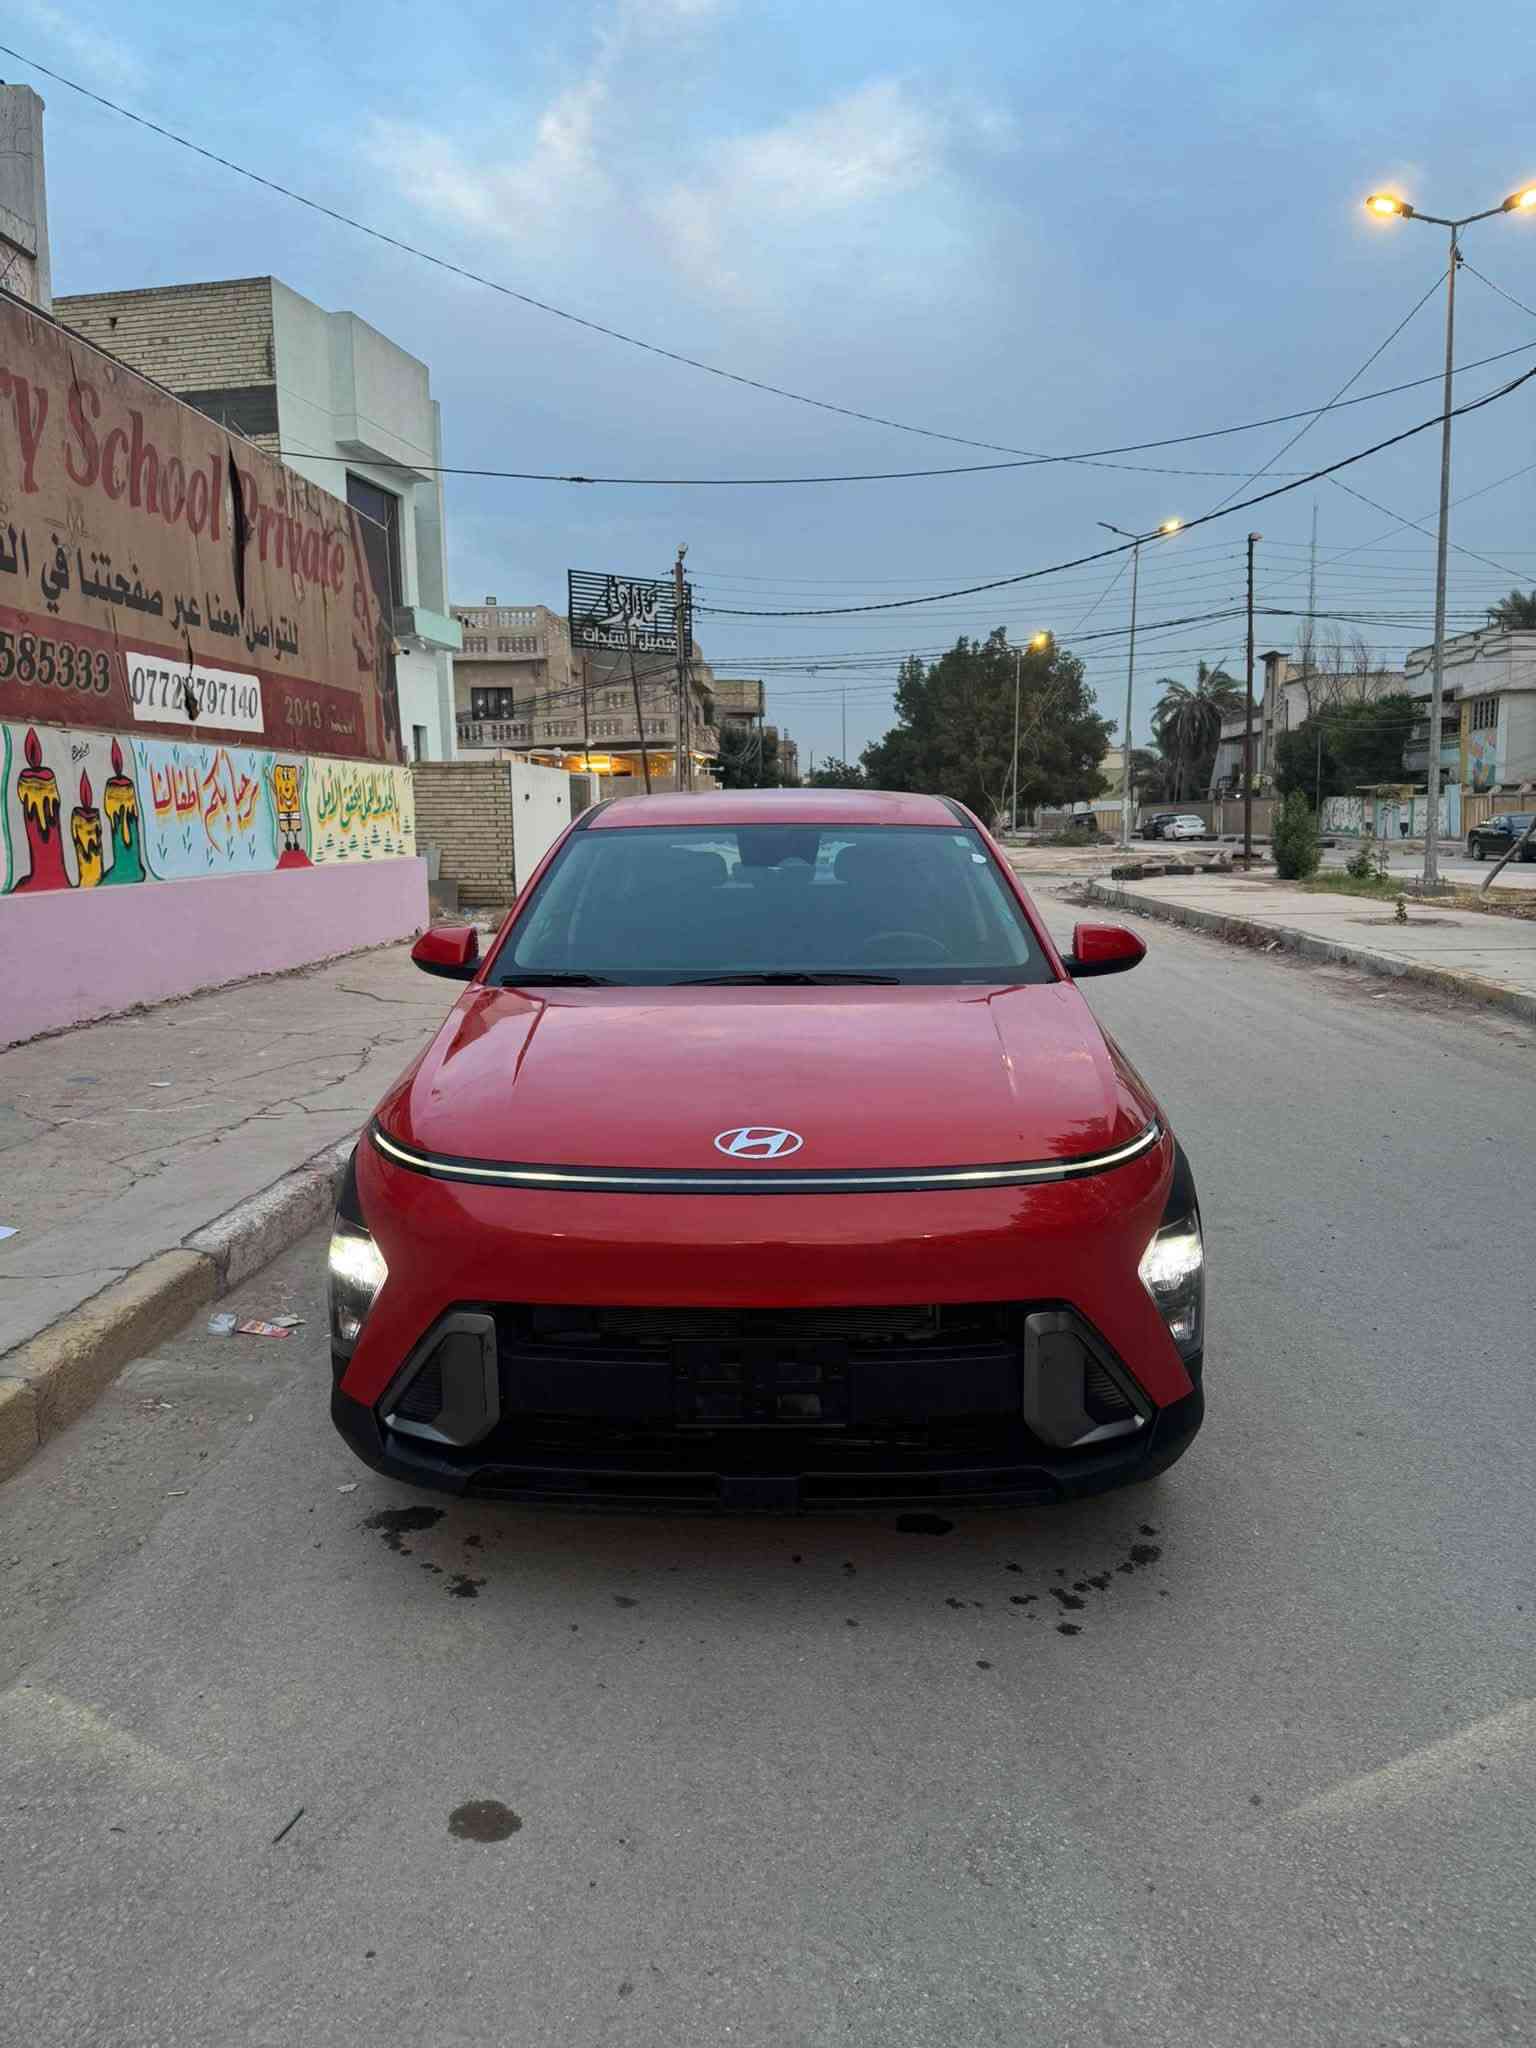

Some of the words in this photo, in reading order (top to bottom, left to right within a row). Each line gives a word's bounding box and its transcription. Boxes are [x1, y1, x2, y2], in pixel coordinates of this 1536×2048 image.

[63, 380, 221, 543] School
[41, 533, 70, 614] في
[77, 547, 163, 617] صفحتنا
[168, 591, 201, 640] عبر
[205, 591, 240, 637] معنا
[245, 608, 298, 661] للتواصل
[283, 695, 321, 729] 2013
